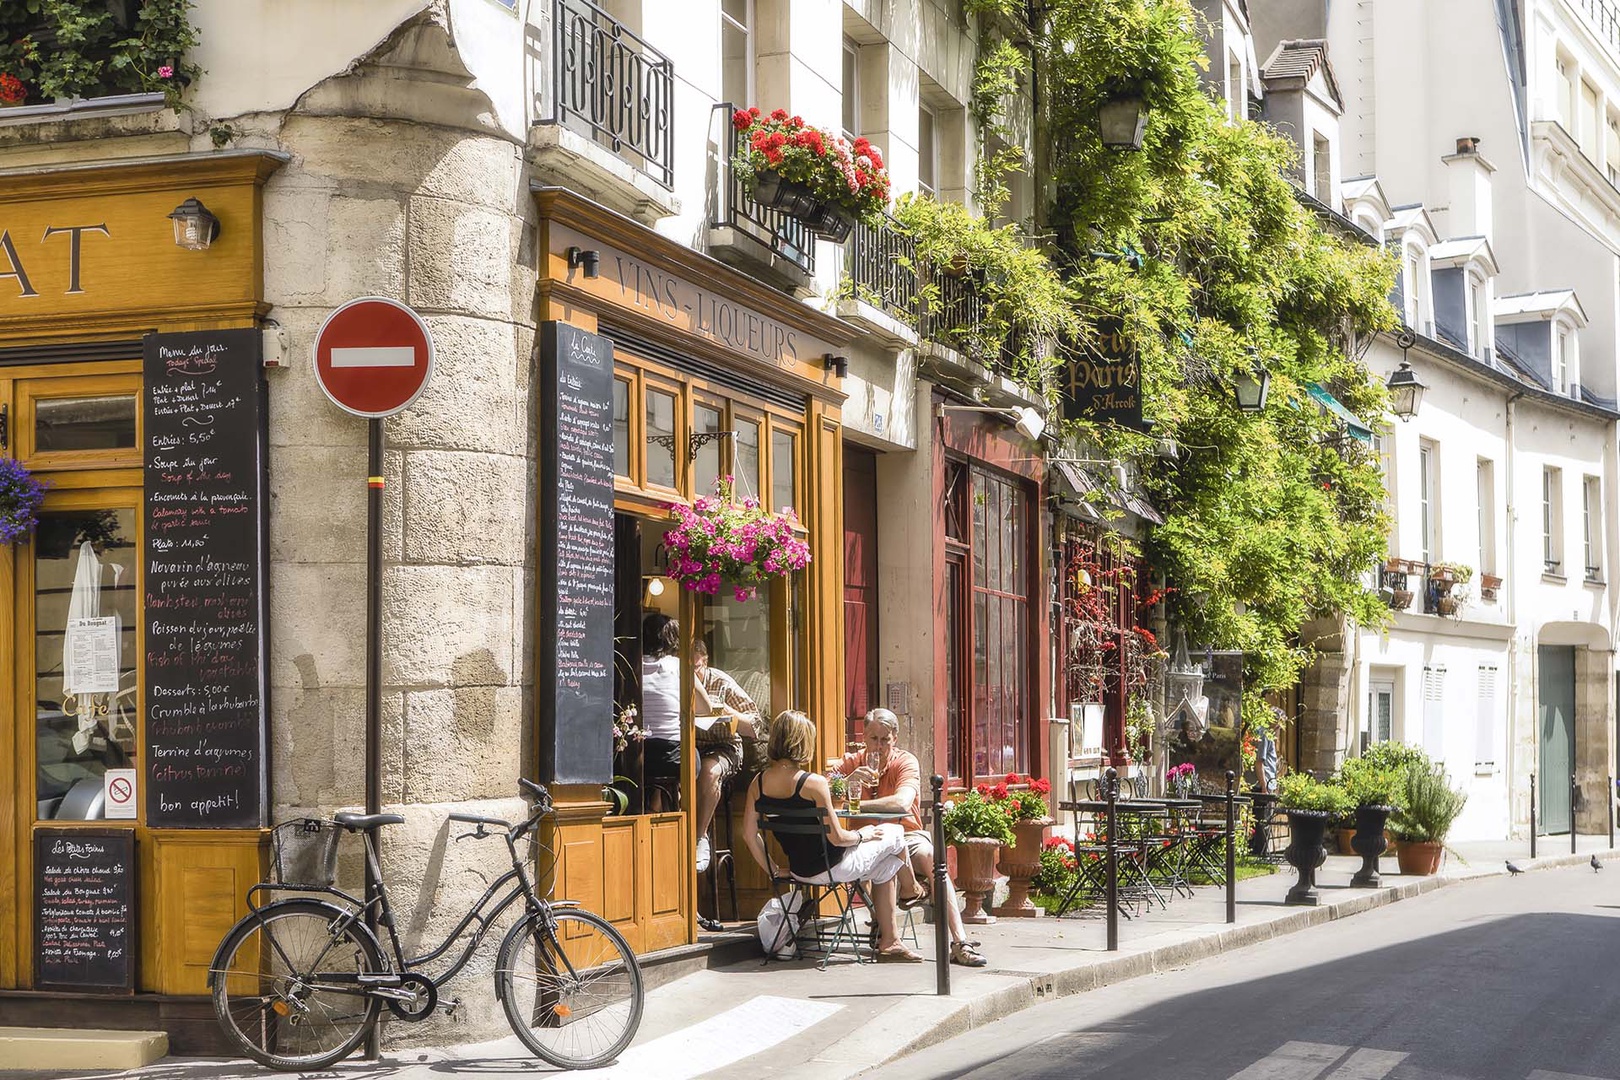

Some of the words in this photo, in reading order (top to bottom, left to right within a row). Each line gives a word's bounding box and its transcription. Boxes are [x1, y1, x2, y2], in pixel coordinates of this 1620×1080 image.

[616, 257, 679, 320] VINS
[697, 293, 797, 368] LIQUEURS
[159, 346, 185, 358] Menu
[189, 345, 202, 356] du
[1063, 360, 1137, 398] Paris
[153, 384, 173, 394] Entrée
[199, 458, 218, 472] jour
[200, 491, 208, 501] la
[152, 621, 186, 635] Poisson
[151, 702, 196, 720] Crumble
[152, 745, 189, 757] Terrine
[160, 793, 181, 812] bon
